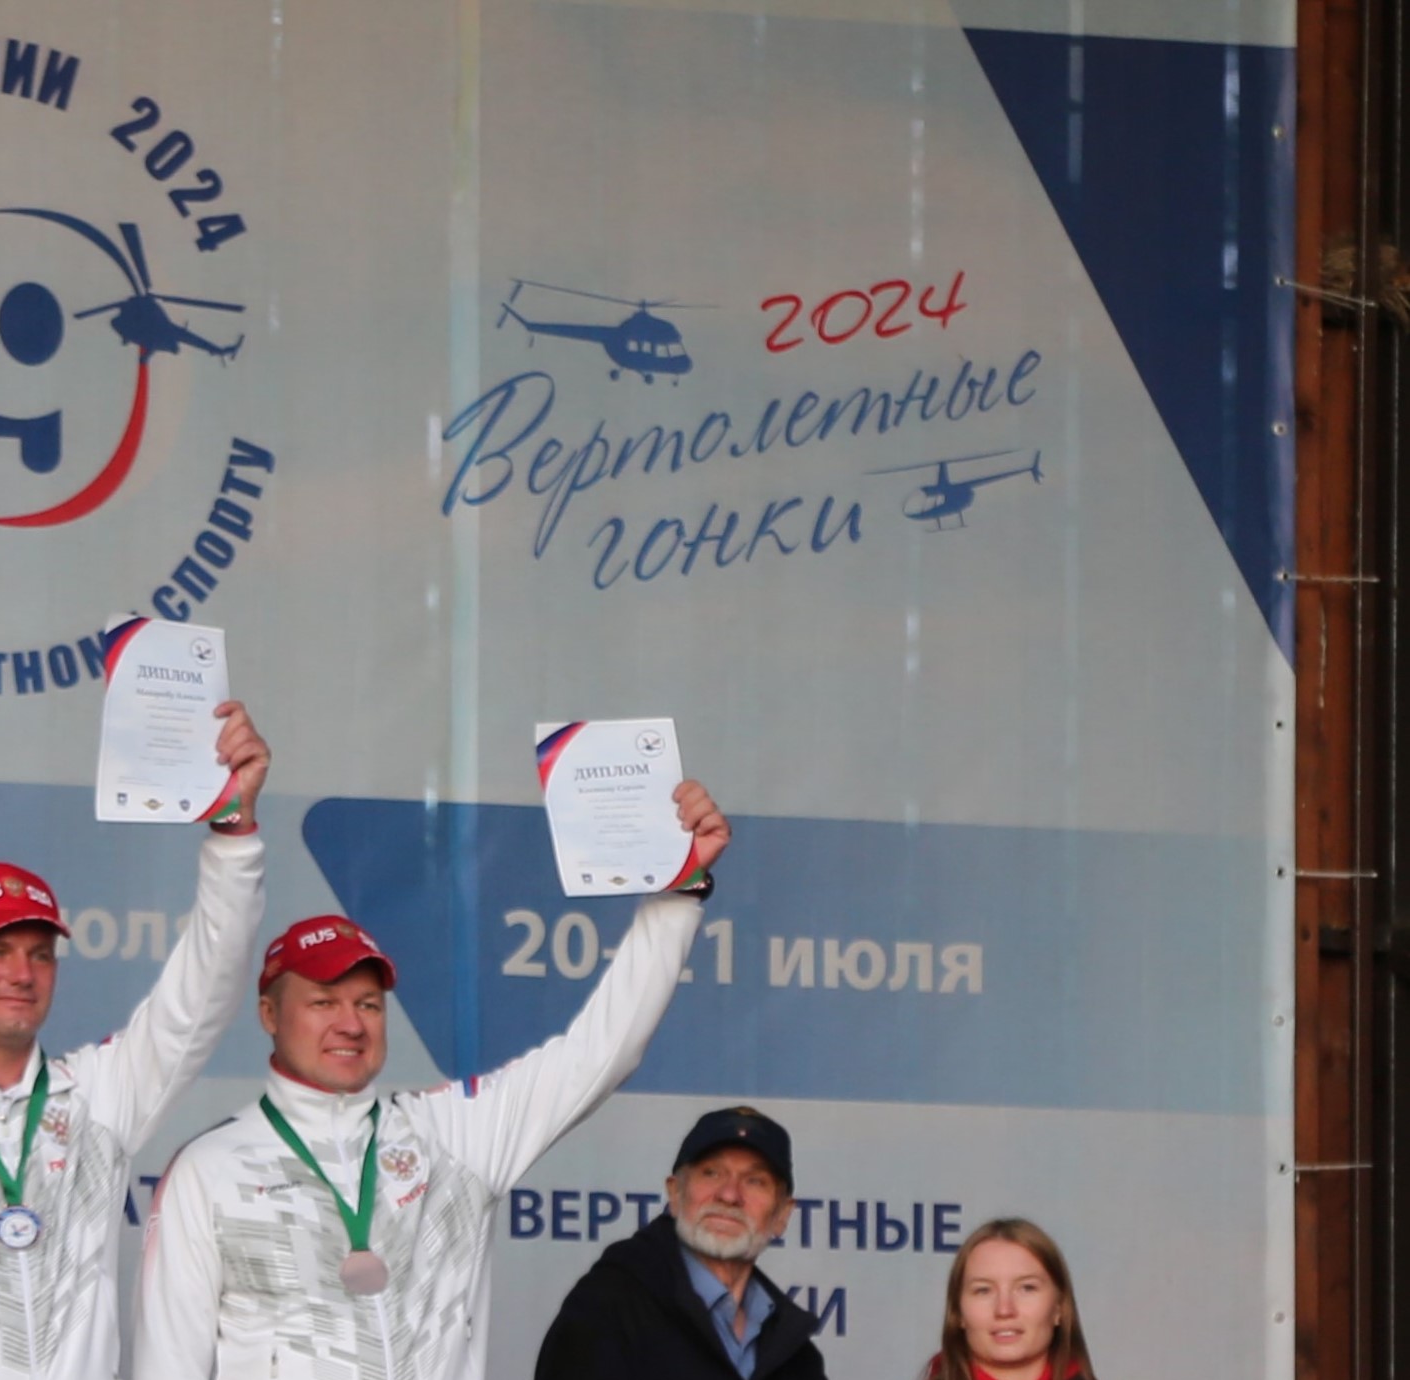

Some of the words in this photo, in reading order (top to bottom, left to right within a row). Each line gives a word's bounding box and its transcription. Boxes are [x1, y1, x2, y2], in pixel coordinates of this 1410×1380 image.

[109, 96, 248, 254] 2024
[761, 271, 967, 352] 2024
[440, 349, 1043, 560] Вертолетные
[152, 437, 276, 622] спорту
[585, 495, 863, 591] гонки
[137, 664, 204, 685] ДИПЛОМ
[574, 762, 651, 781] ДИПЛОМ
[298, 927, 338, 950] RUS
[769, 936, 983, 994] июля
[509, 1188, 964, 1254] ВЕРТТНЫЕ
